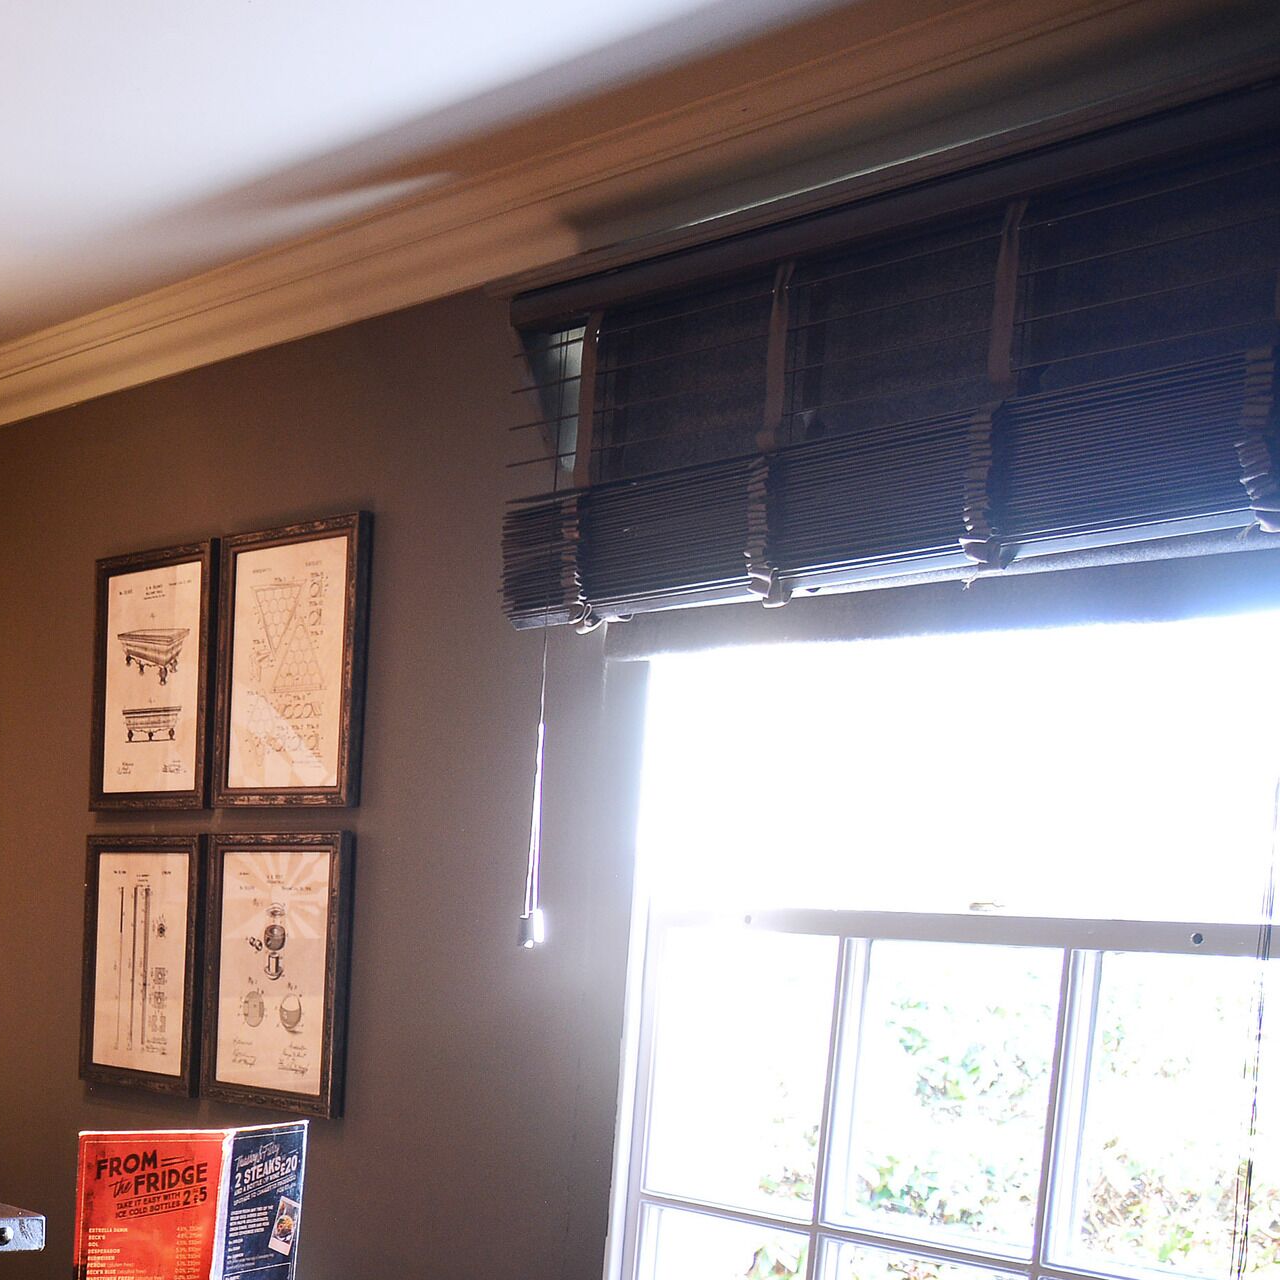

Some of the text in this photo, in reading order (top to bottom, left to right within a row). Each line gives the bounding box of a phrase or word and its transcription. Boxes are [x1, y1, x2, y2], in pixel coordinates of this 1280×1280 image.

[95, 1149, 158, 1180] FROM
[234, 1172, 242, 1188] 2
[243, 1155, 281, 1185] STEAKS
[134, 1162, 208, 1195] FRIDGE
[115, 1201, 180, 1219] ICE COLD BOTTLES
[116, 1201, 133, 1210] TAKE
[143, 1195, 162, 1205] EASY
[163, 1192, 181, 1202] WITH
[182, 1190, 191, 1206] 2
